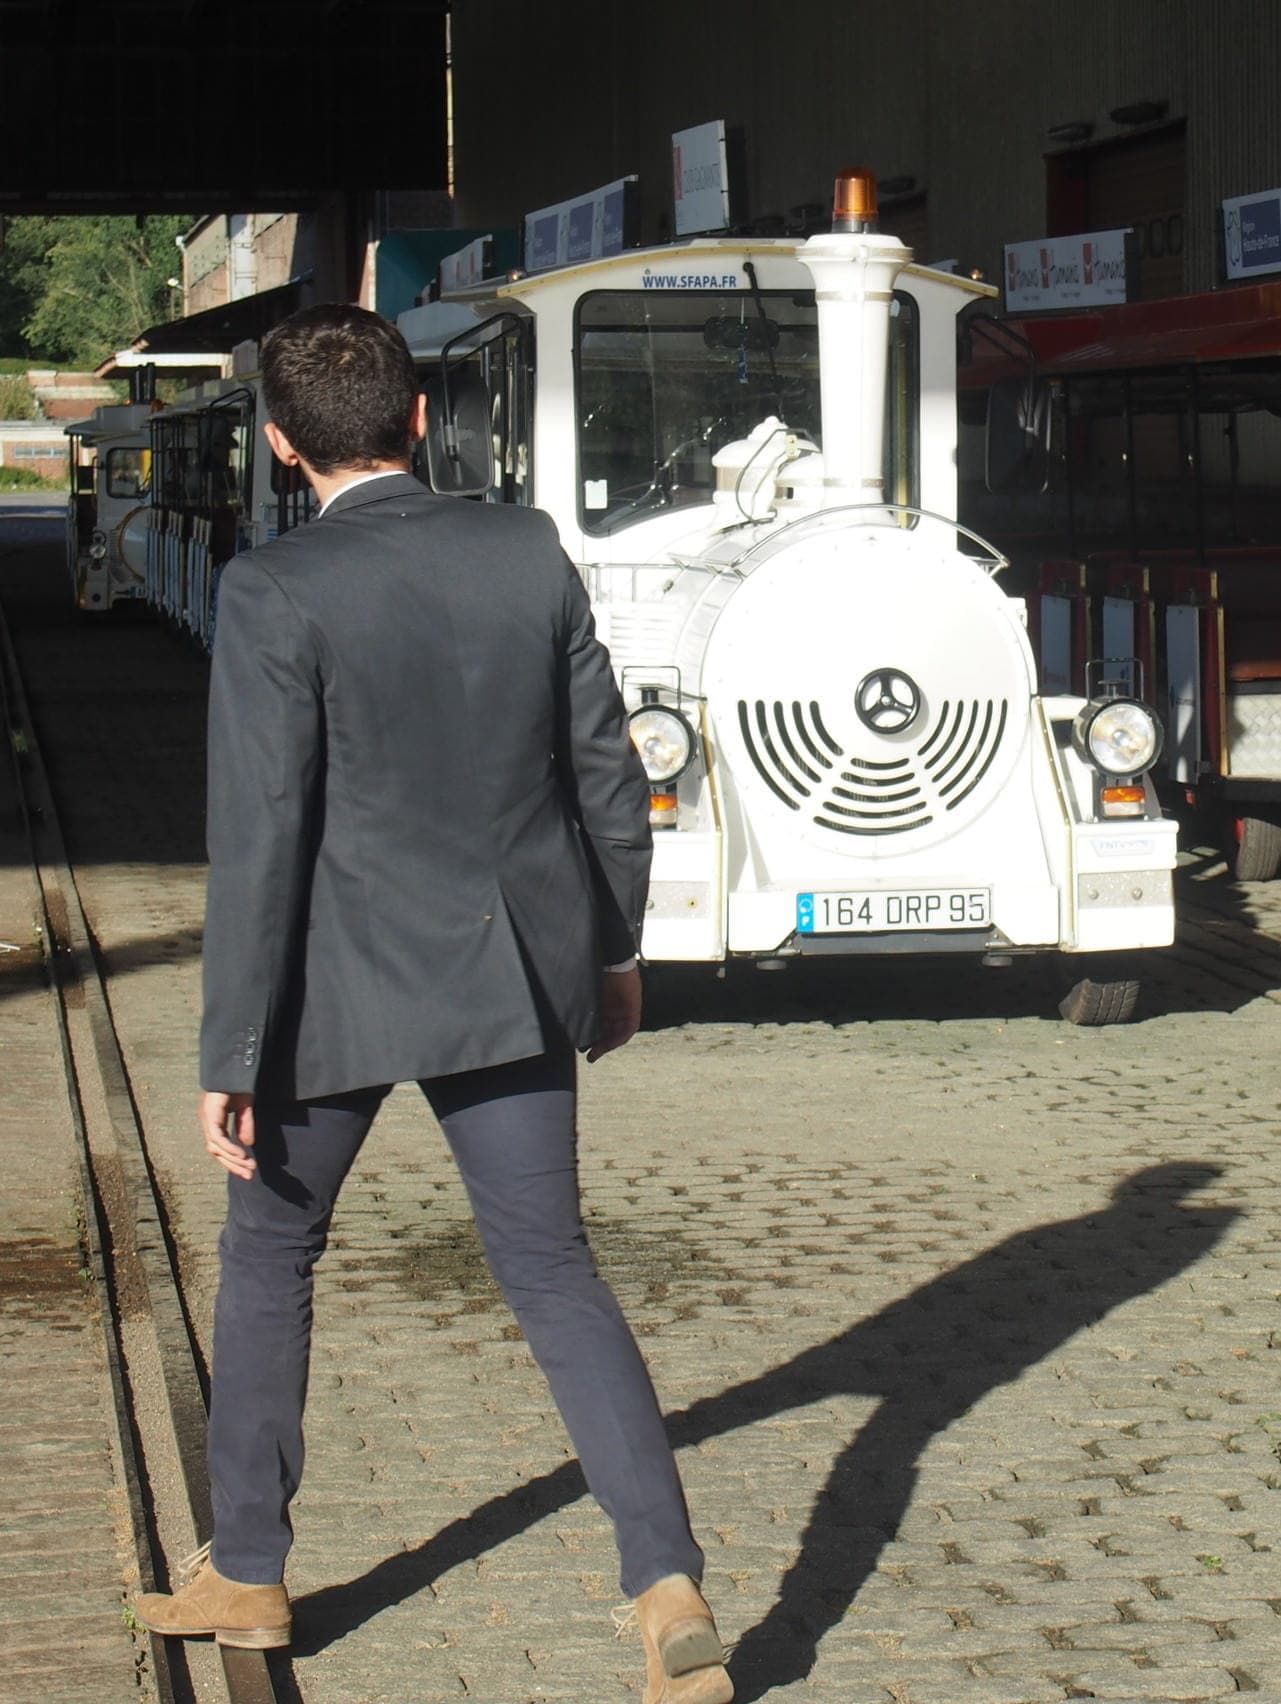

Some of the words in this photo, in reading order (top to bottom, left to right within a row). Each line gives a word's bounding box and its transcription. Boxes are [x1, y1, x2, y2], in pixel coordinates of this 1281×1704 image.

[642, 275, 737, 289] WWW.SFAPA.FR
[823, 896, 873, 926] 164
[887, 895, 941, 925] DRP
[949, 894, 985, 922] 95
